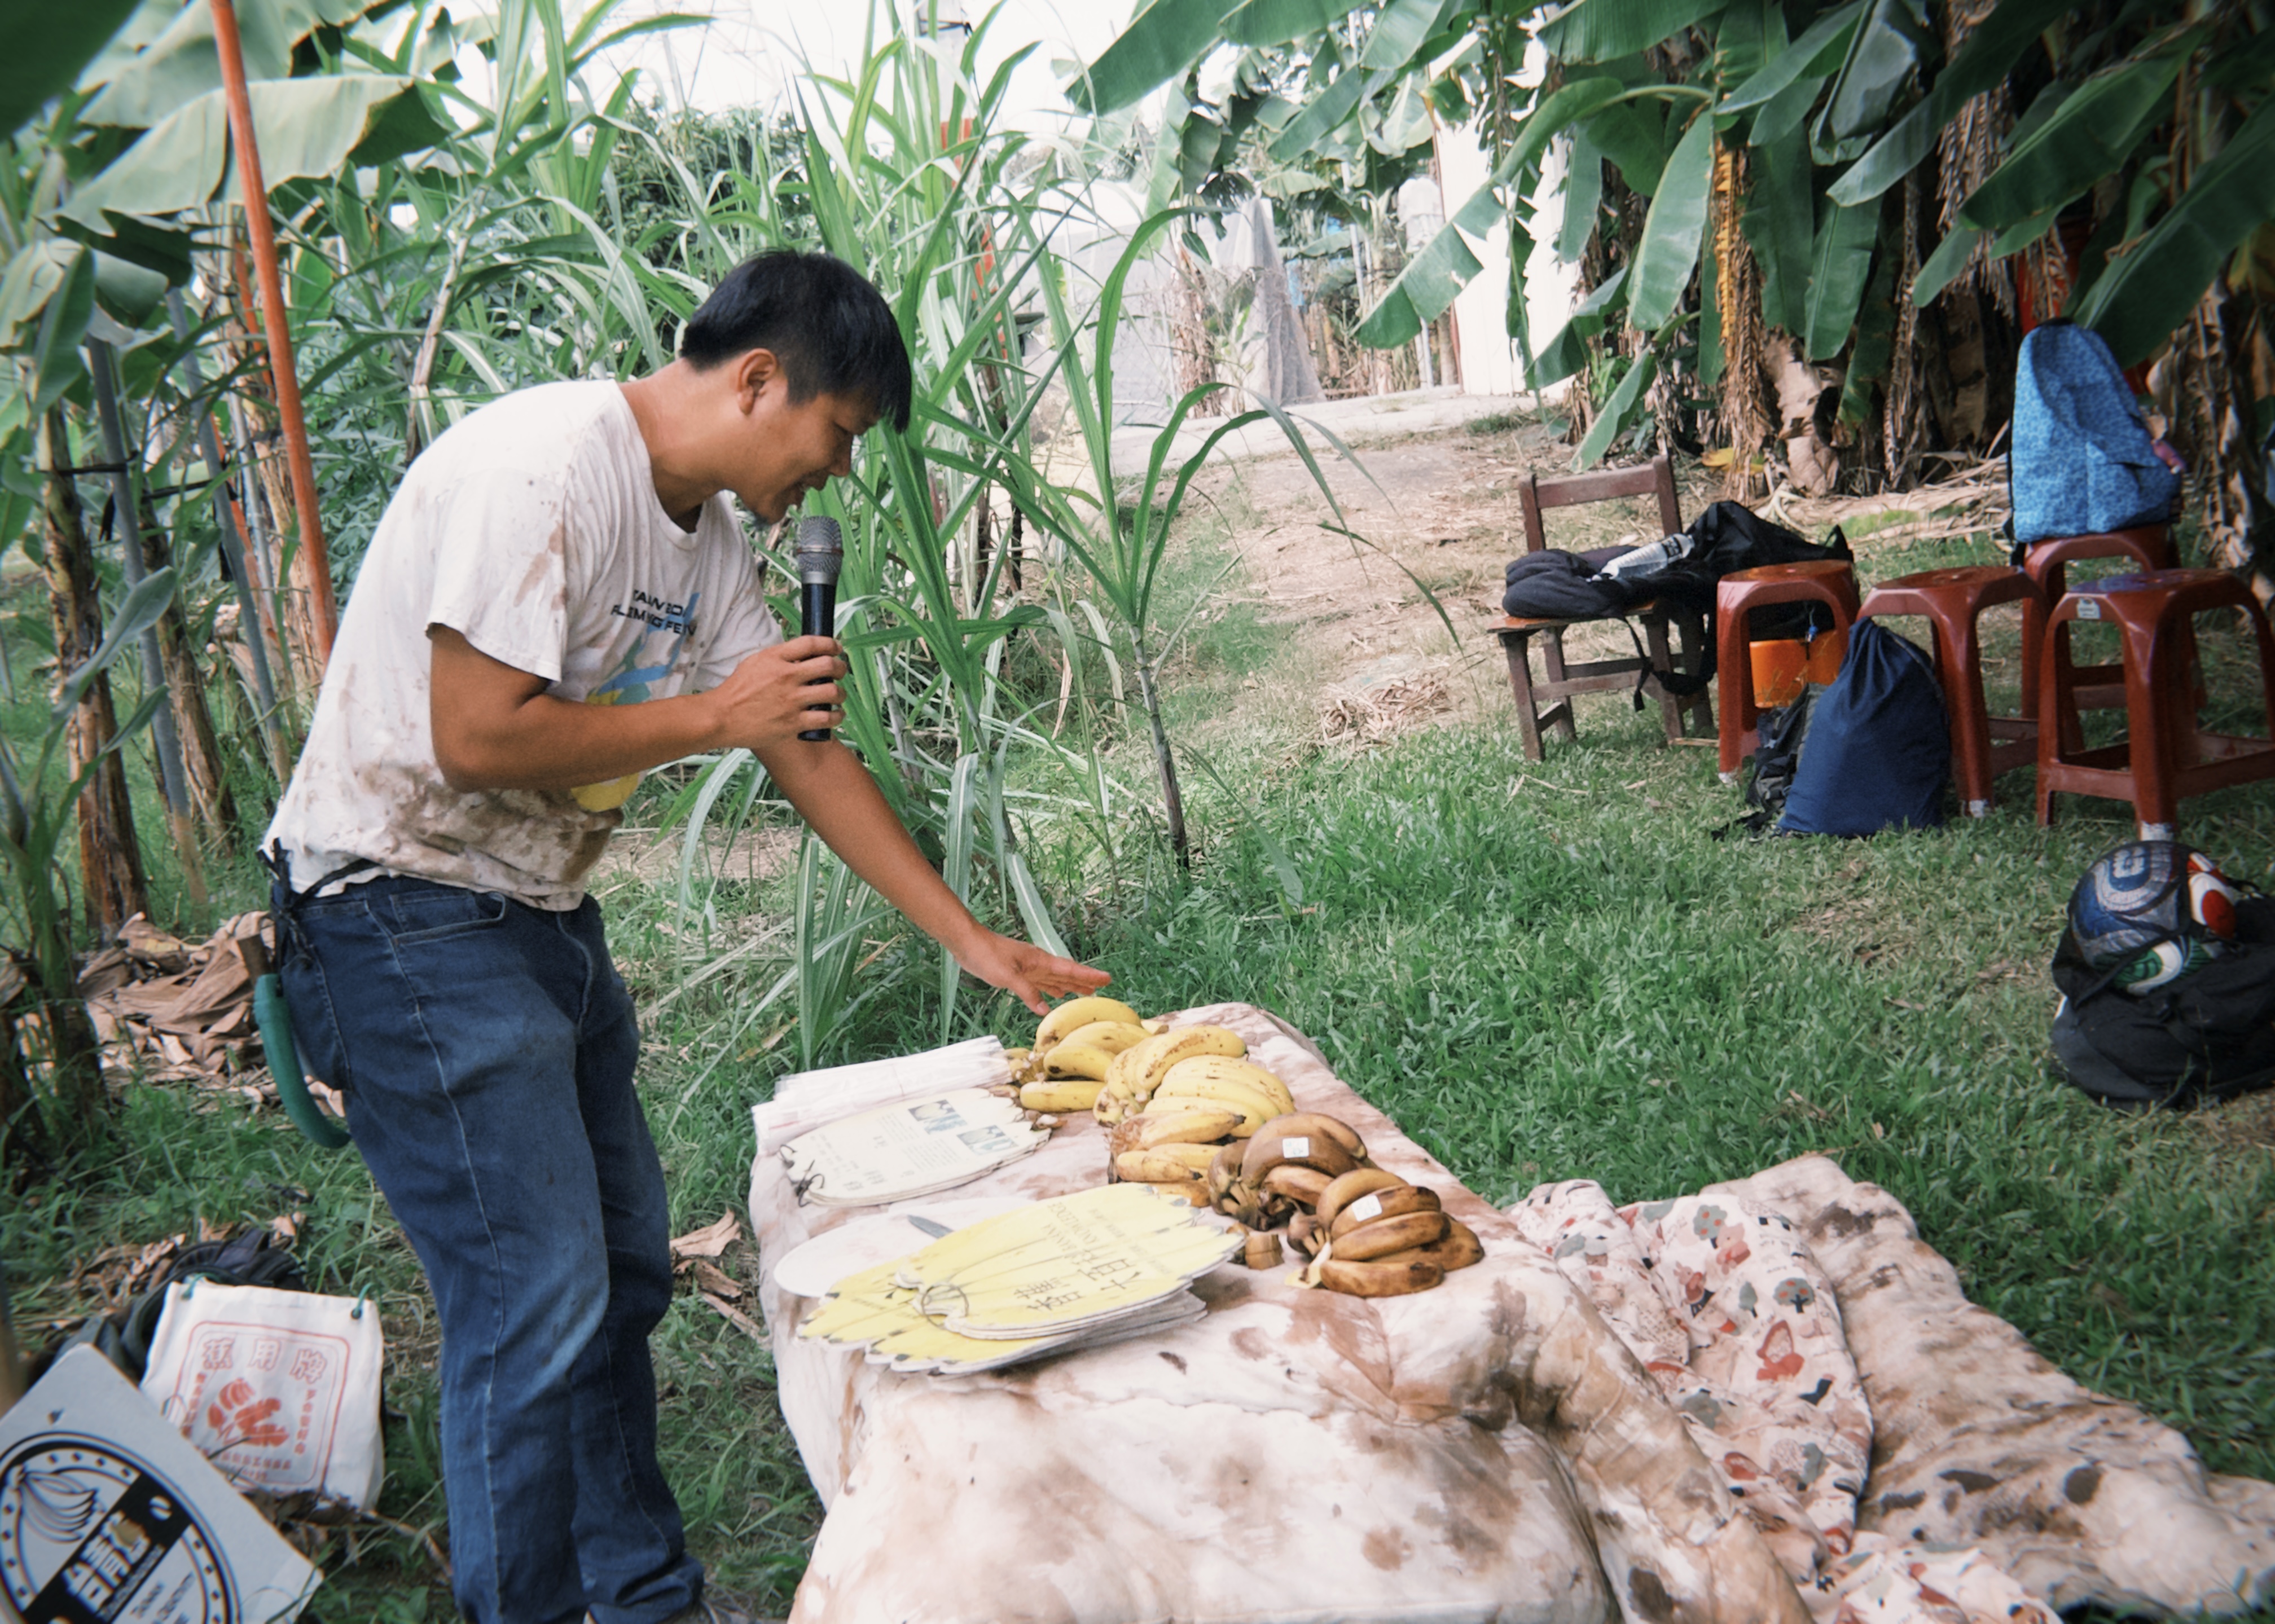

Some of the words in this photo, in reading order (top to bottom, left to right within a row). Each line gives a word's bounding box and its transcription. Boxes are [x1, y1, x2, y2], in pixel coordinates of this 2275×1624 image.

[1043, 1222, 1077, 1252] BANANA
[1047, 1202, 1098, 1244] KNOWLEDGE
[1064, 1248, 1141, 1290] 大百科
[1013, 1275, 1083, 1311] 香蕉
